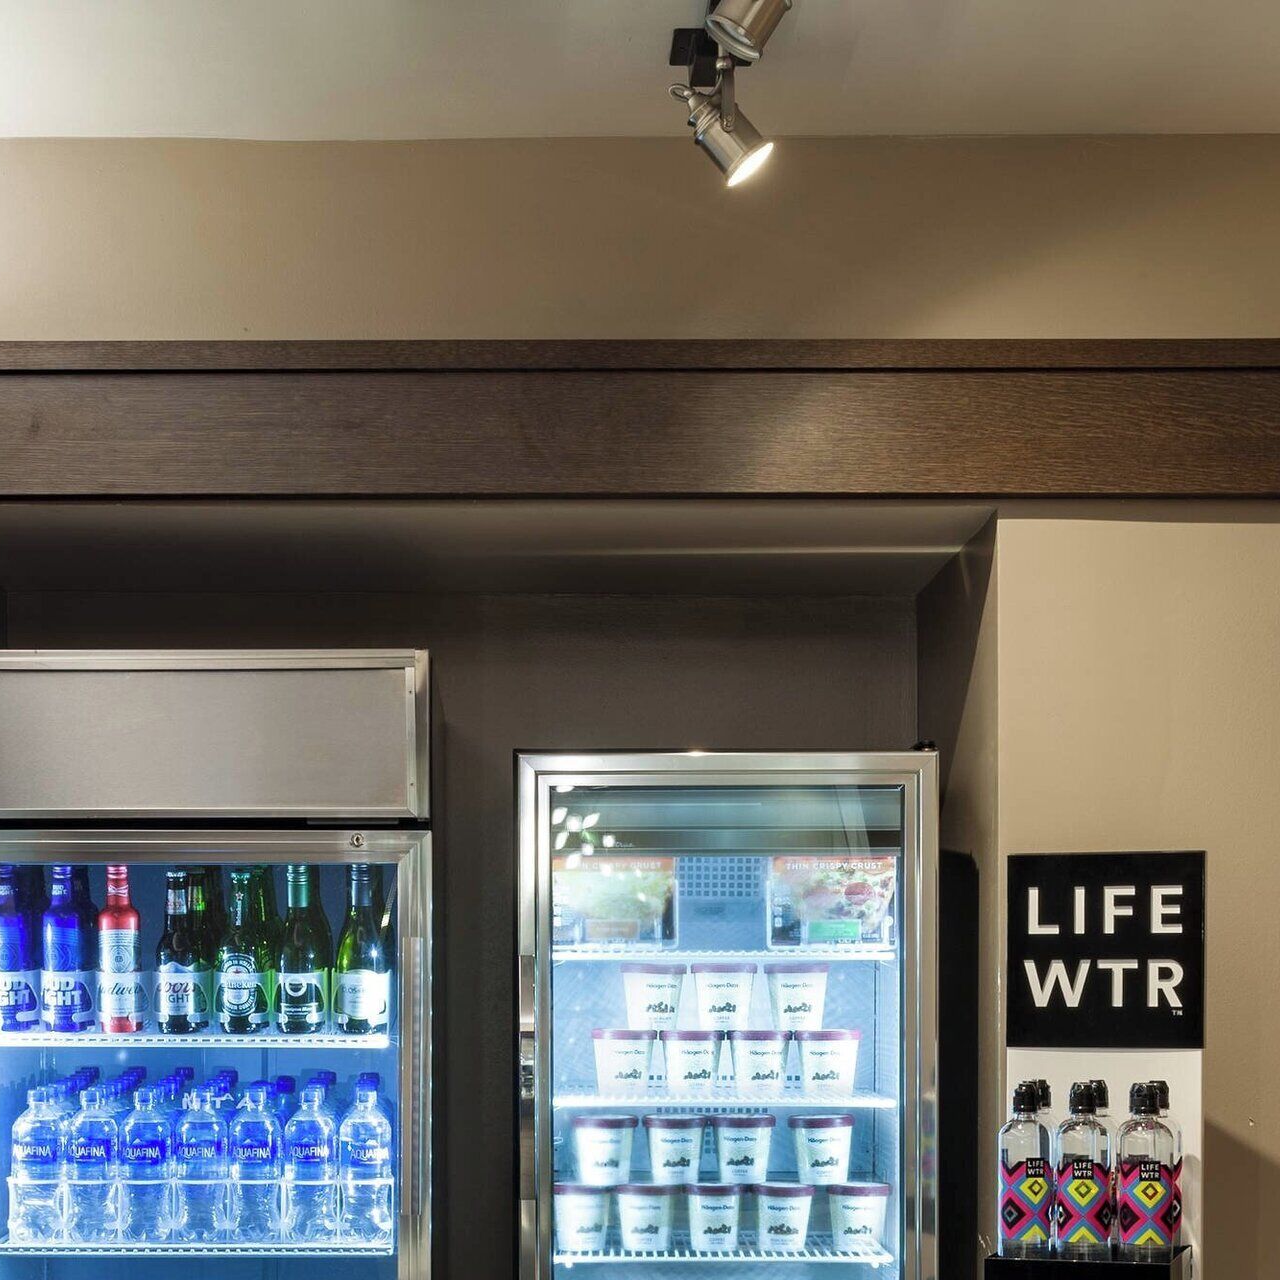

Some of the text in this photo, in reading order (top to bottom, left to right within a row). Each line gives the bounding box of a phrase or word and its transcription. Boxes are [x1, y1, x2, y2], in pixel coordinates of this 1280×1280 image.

[1028, 885, 1183, 934] LIFE
[1024, 959, 1184, 1007] WTR
[122, 1146, 160, 1159] AQUAFINA
[179, 1146, 216, 1159] AQUAFINA
[233, 1146, 271, 1159] AQUAFINA
